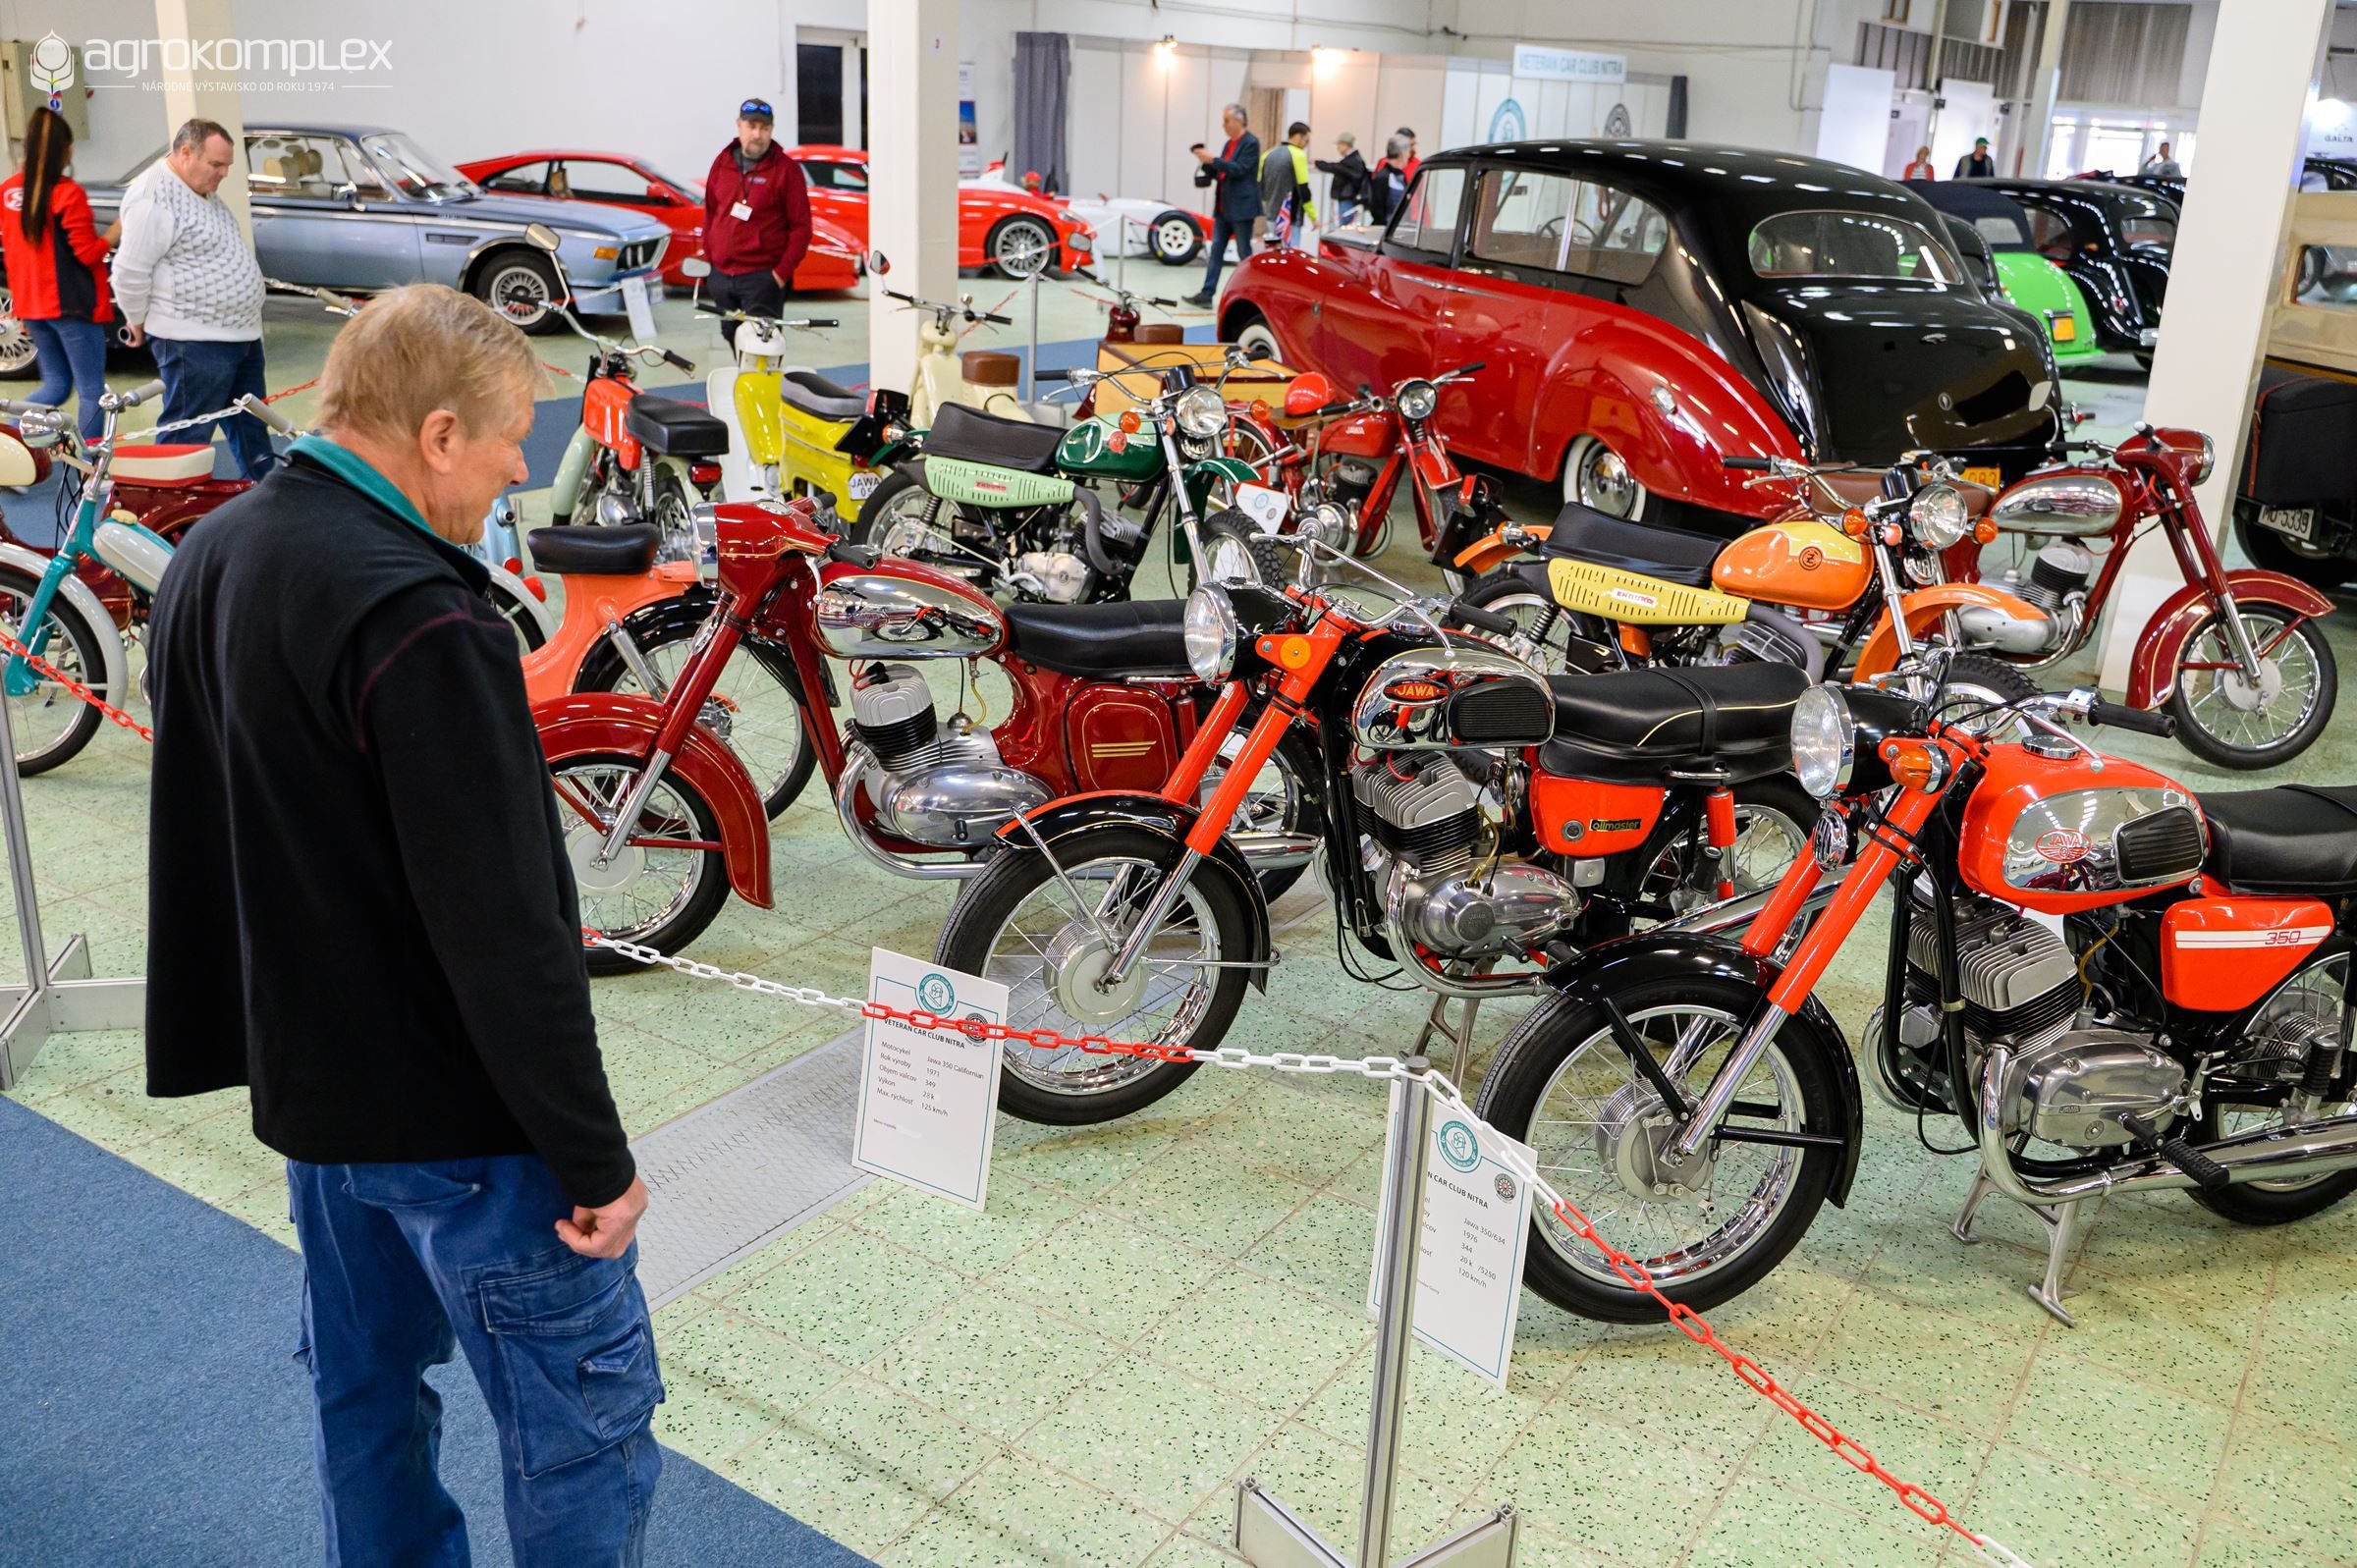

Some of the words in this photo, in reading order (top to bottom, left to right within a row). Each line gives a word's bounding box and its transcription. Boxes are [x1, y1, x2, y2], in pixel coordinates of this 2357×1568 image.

[1398, 684, 1435, 697] JAWA
[2048, 835, 2081, 846] JAWA
[2265, 930, 2301, 946] 350
[884, 1018, 912, 1033] VETERAN
[913, 1028, 927, 1037] CAR
[927, 1032, 945, 1043] CLUB
[945, 1037, 965, 1050] NITRA
[881, 1041, 911, 1055] Motocykel
[880, 1052, 891, 1061] Rok
[879, 1064, 899, 1077] Objem
[926, 1067, 940, 1077] 1971
[942, 1060, 953, 1070] 350
[954, 1064, 985, 1080] Californian
[1433, 1174, 1448, 1187] CAR
[1448, 1182, 1466, 1197] CLUB
[1467, 1192, 1489, 1209] NITRA
[1462, 1229, 1478, 1243] 1976
[1480, 1225, 1507, 1245] 350/634
